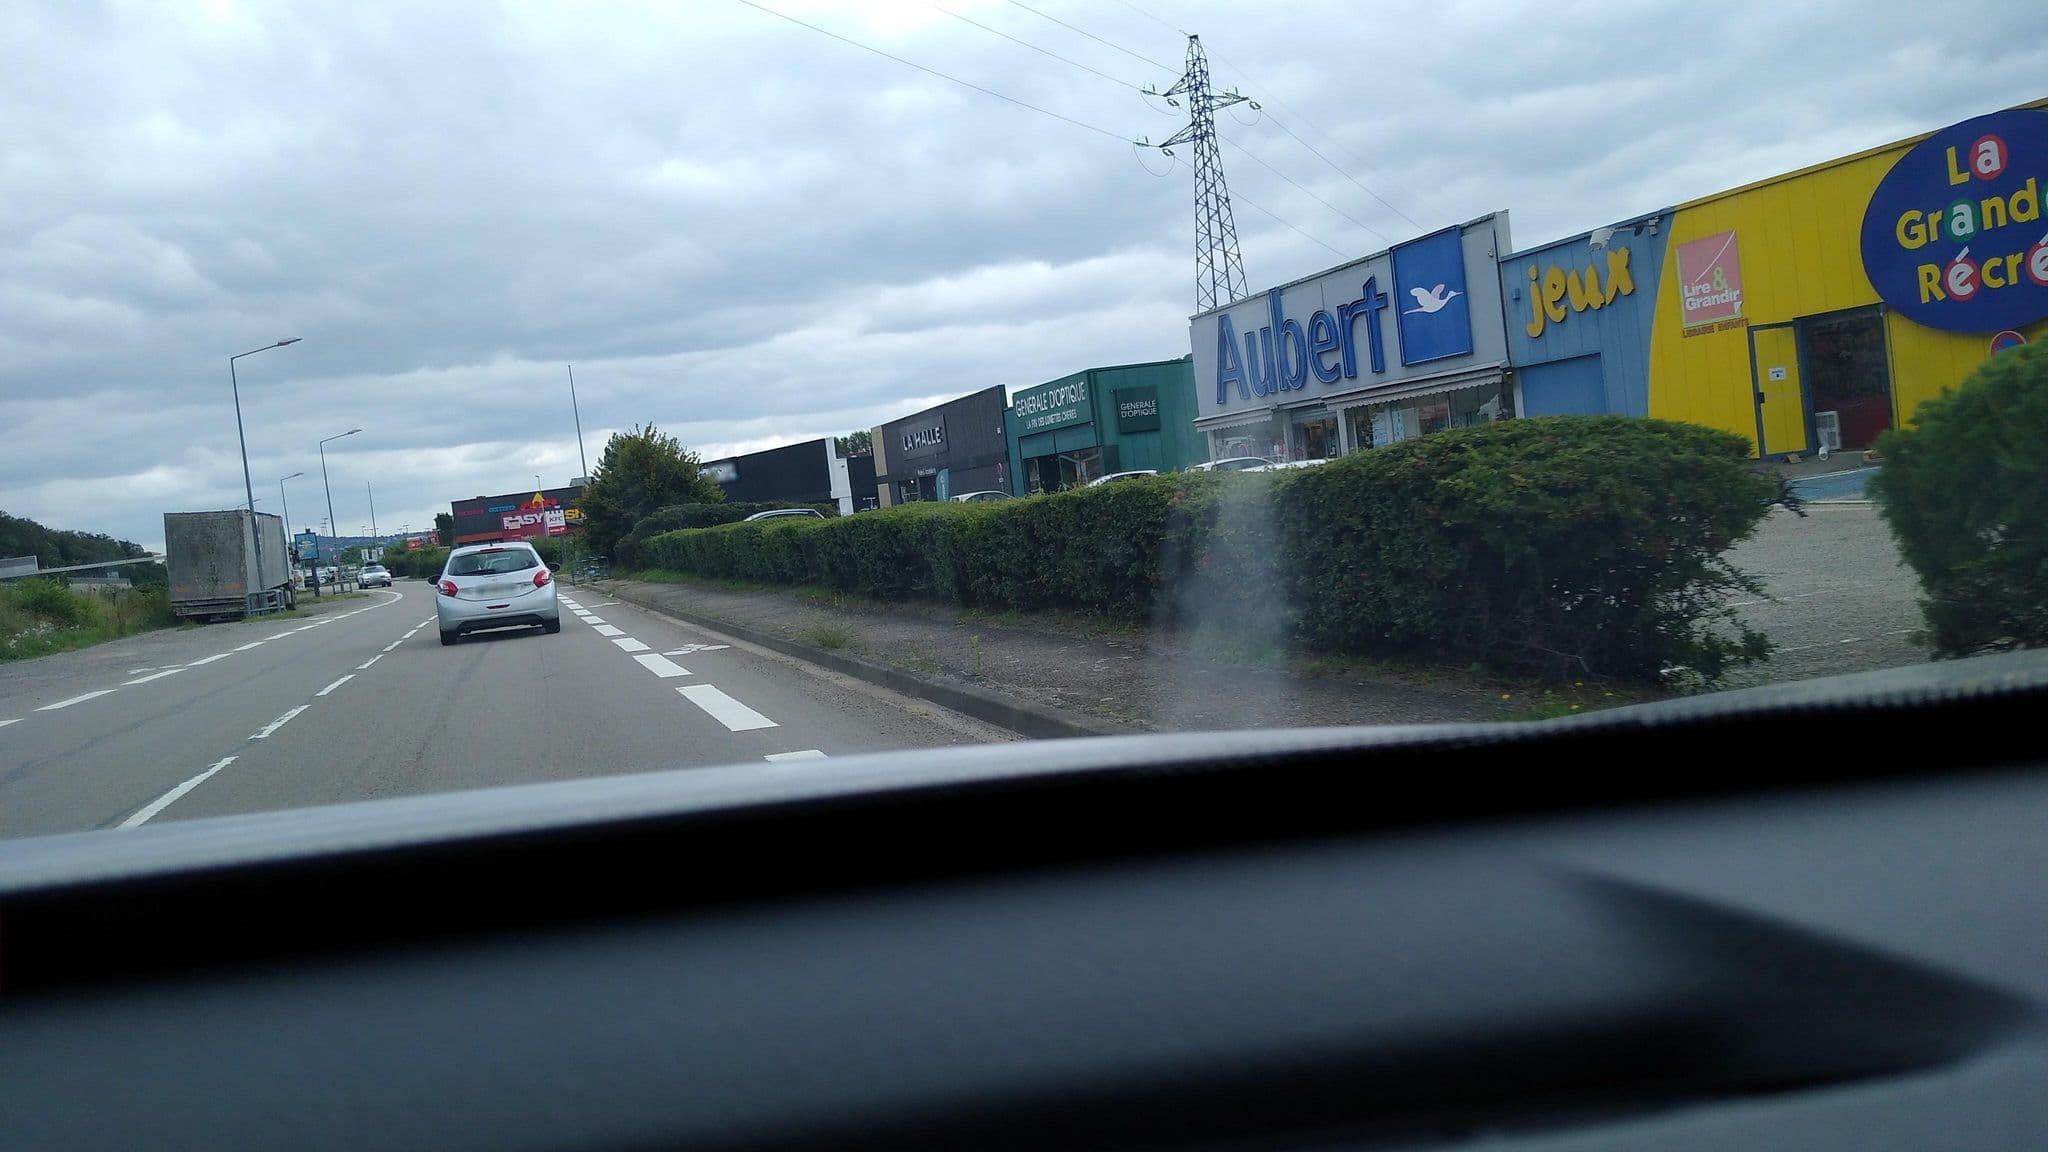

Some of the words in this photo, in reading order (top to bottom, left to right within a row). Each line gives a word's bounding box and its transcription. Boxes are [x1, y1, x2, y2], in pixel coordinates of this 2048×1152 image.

[1946, 140, 2001, 186] La
[1896, 176, 2048, 250] Grand
[1525, 246, 1635, 338] jeux
[1684, 282, 1711, 298] Lire
[1712, 266, 1728, 291] &
[1685, 288, 1740, 311] Grandir
[1215, 274, 1388, 405] Aubert
[1015, 392, 1048, 418] GENERALE
[1049, 381, 1086, 409] D'OPTIQUE
[1120, 400, 1157, 411] GENERALE
[1121, 407, 1157, 418] D'OPTIQUE
[903, 435, 914, 451] LA
[915, 427, 942, 448] HALLE
[503, 512, 543, 530] EASY
